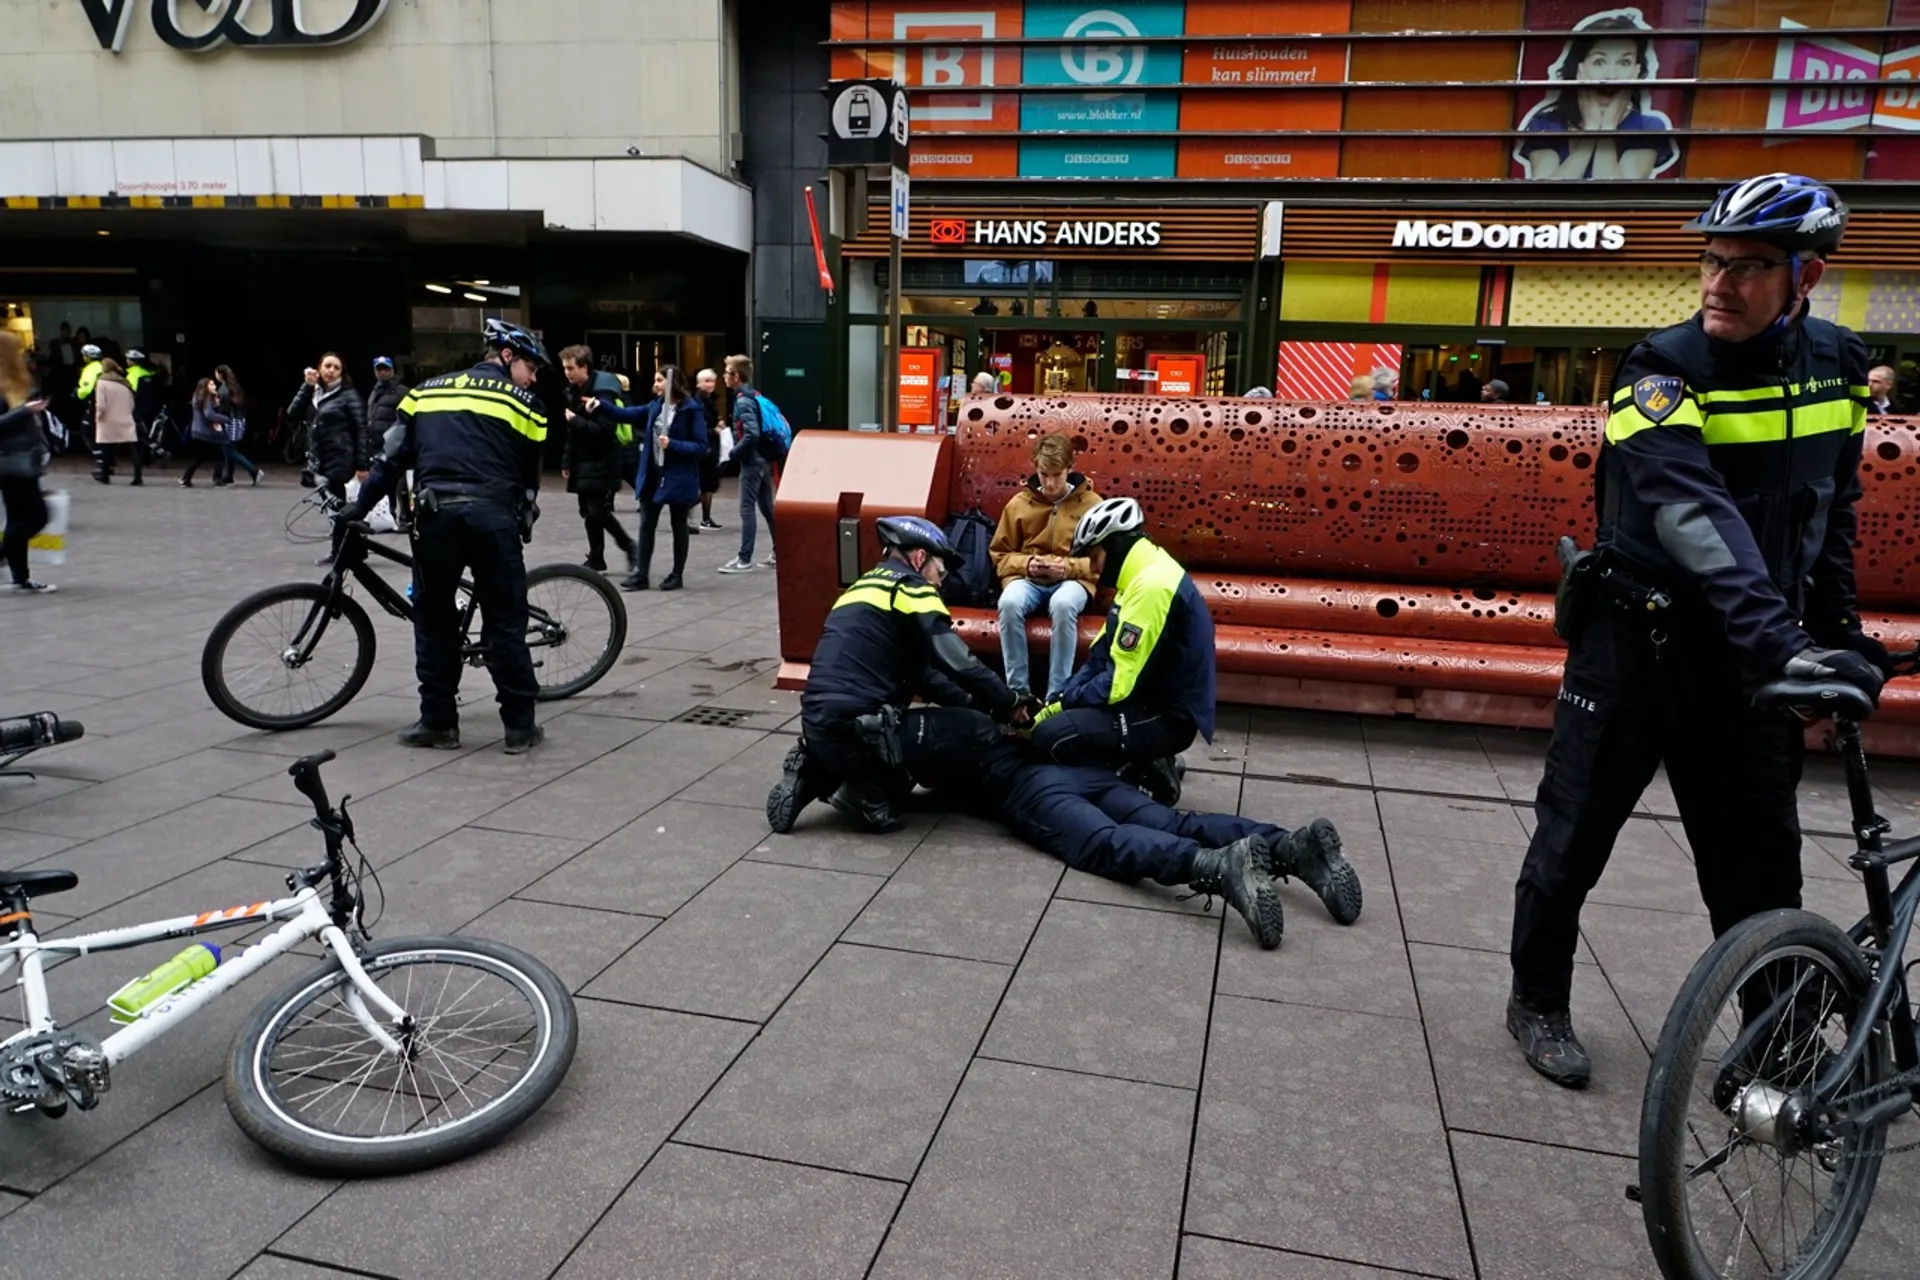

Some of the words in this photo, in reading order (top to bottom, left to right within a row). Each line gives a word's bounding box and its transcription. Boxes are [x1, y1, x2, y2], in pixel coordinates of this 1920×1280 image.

[1212, 46, 1308, 60] Huishouden
[1212, 67, 1240, 81] kan
[1246, 67, 1317, 81] slimmer!
[1057, 109, 1142, 120] www.blokker.nl
[1225, 155, 1291, 164] BLOKKER
[895, 188, 906, 231] H
[974, 221, 1048, 244] HANS
[1054, 222, 1161, 245] ANDERS
[1391, 220, 1626, 250] McDonald's
[444, 373, 513, 393] POLITIE
